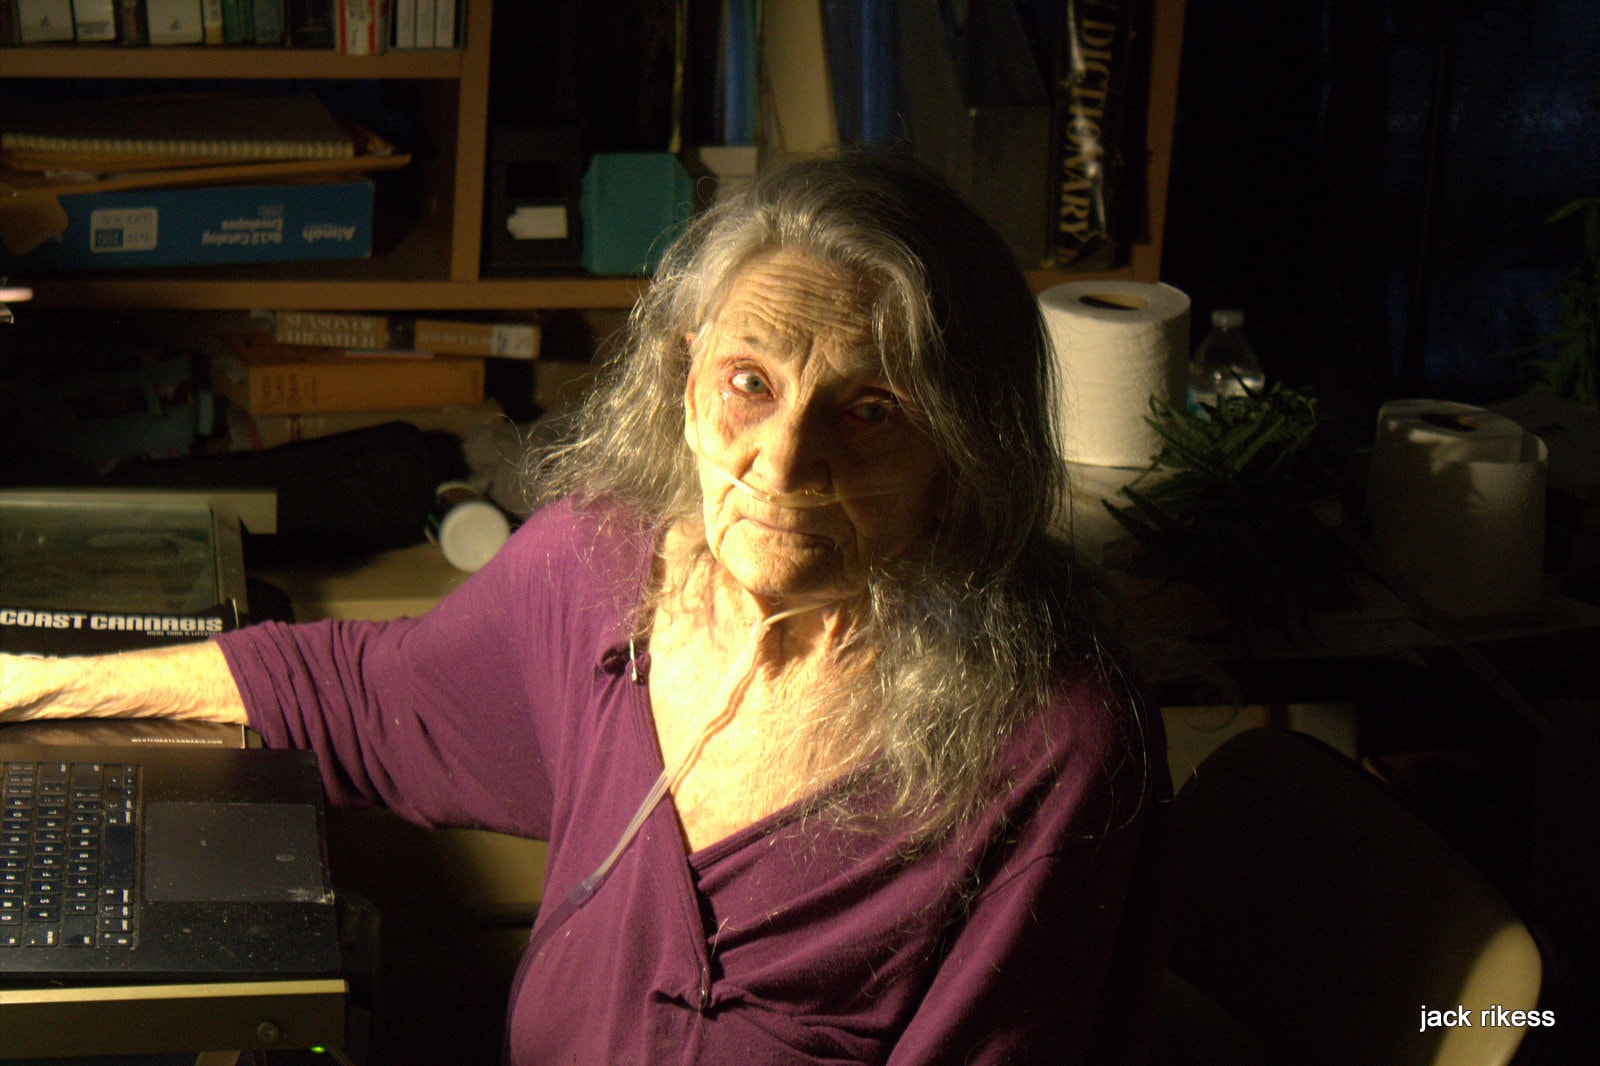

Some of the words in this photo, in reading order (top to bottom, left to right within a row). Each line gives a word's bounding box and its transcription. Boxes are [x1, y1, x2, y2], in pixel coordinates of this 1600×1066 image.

[1059, 18, 1117, 243] DICTIONARY
[0, 609, 88, 630] COAST
[90, 614, 224, 632] CANNABIS
